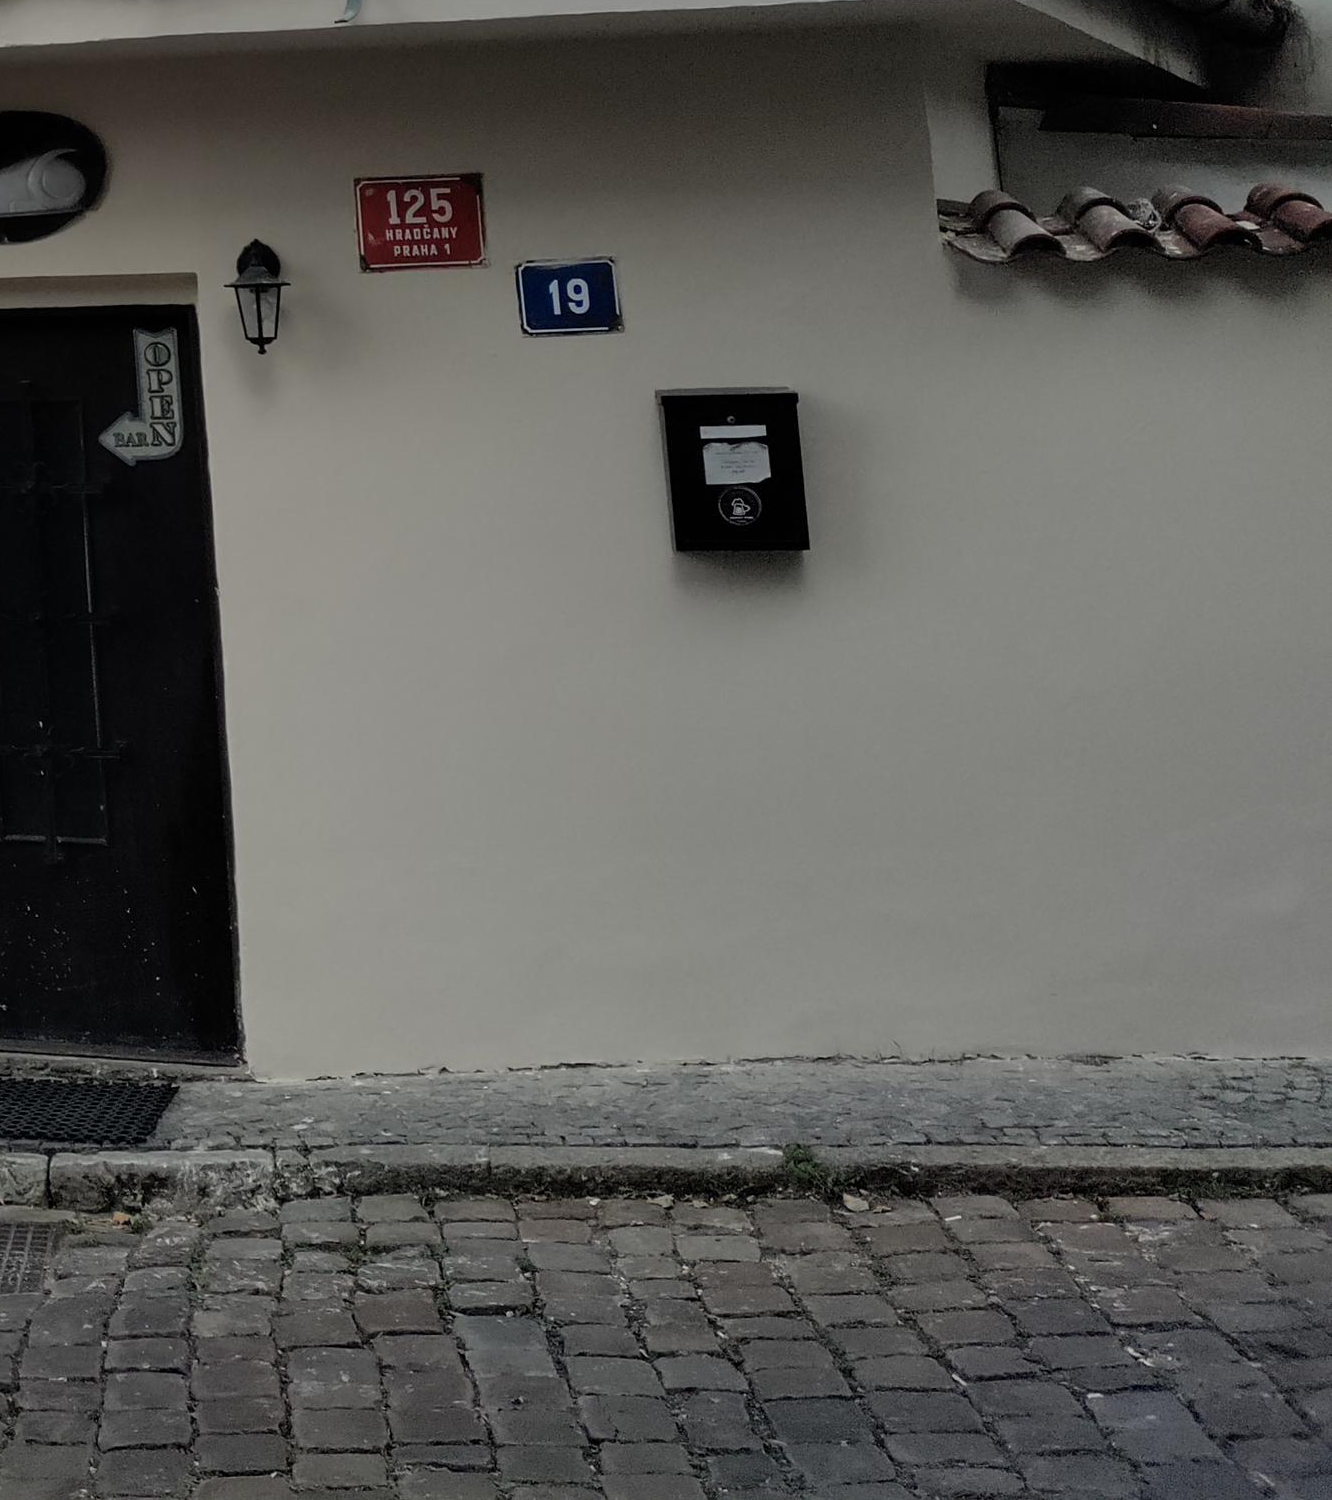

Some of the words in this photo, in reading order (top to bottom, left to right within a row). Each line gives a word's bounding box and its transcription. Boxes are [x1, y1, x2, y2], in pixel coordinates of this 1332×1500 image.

[386, 187, 454, 225] 125
[385, 224, 458, 241] HRADČANY
[393, 244, 438, 257] PRAHA
[444, 243, 451, 255] 1
[549, 278, 590, 315] 19
[143, 341, 177, 447] OPEN
[113, 432, 149, 447] BAR
